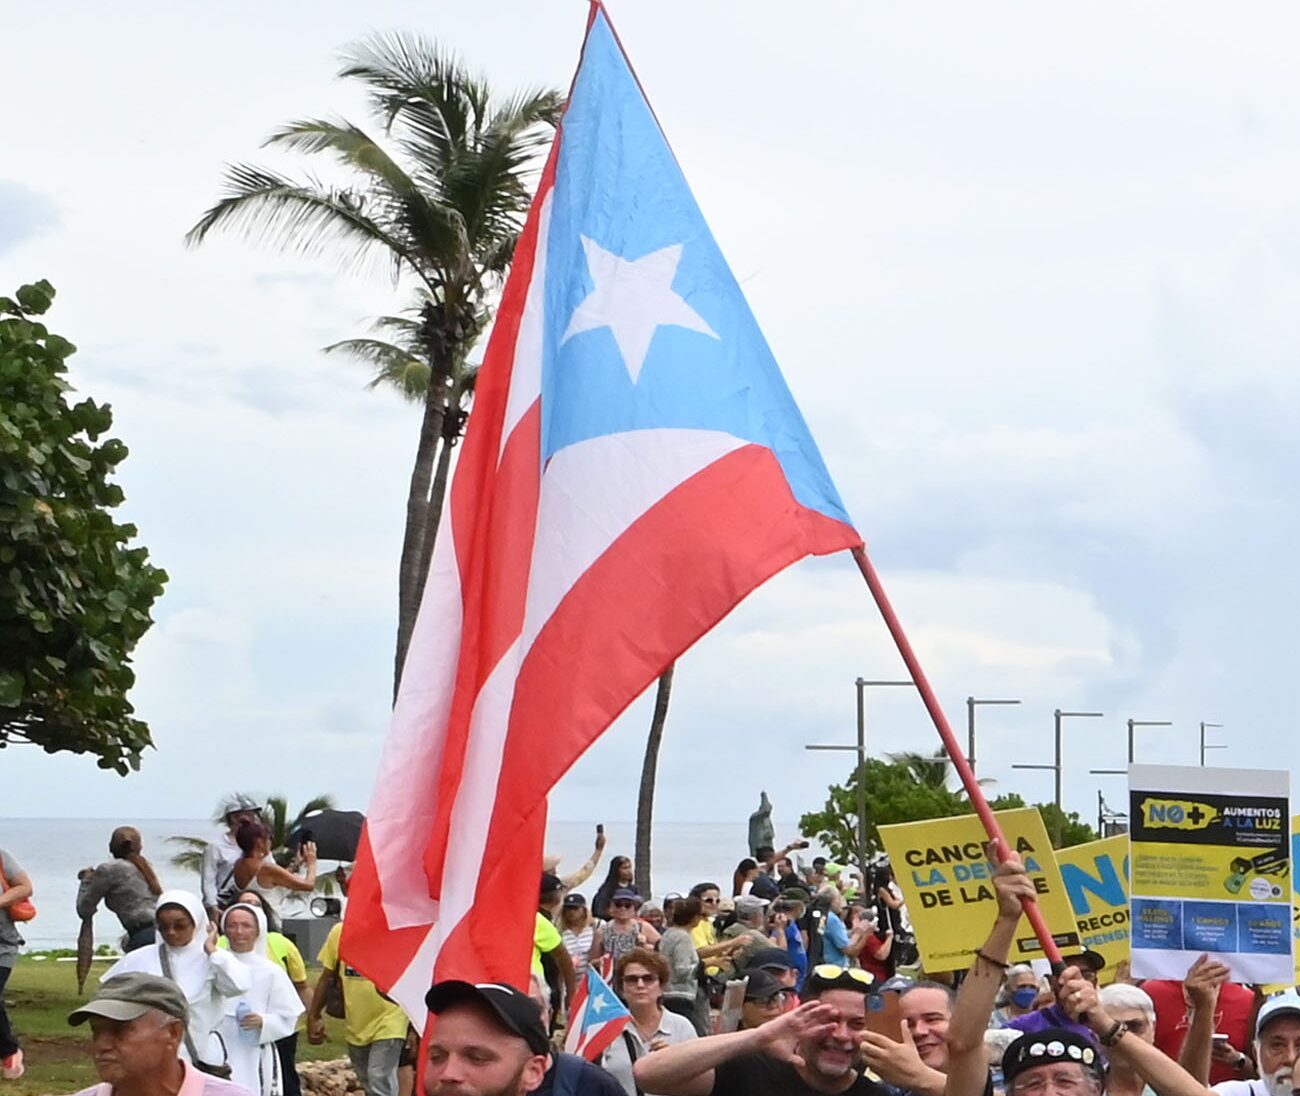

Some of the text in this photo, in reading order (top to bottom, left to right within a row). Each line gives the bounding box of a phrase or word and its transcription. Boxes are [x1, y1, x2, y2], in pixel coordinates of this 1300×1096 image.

[1223, 818, 1281, 830] A LA LUZ
[904, 836, 1035, 867] CANCA
[911, 868, 947, 887] LA
[919, 884, 995, 909] DE LA
